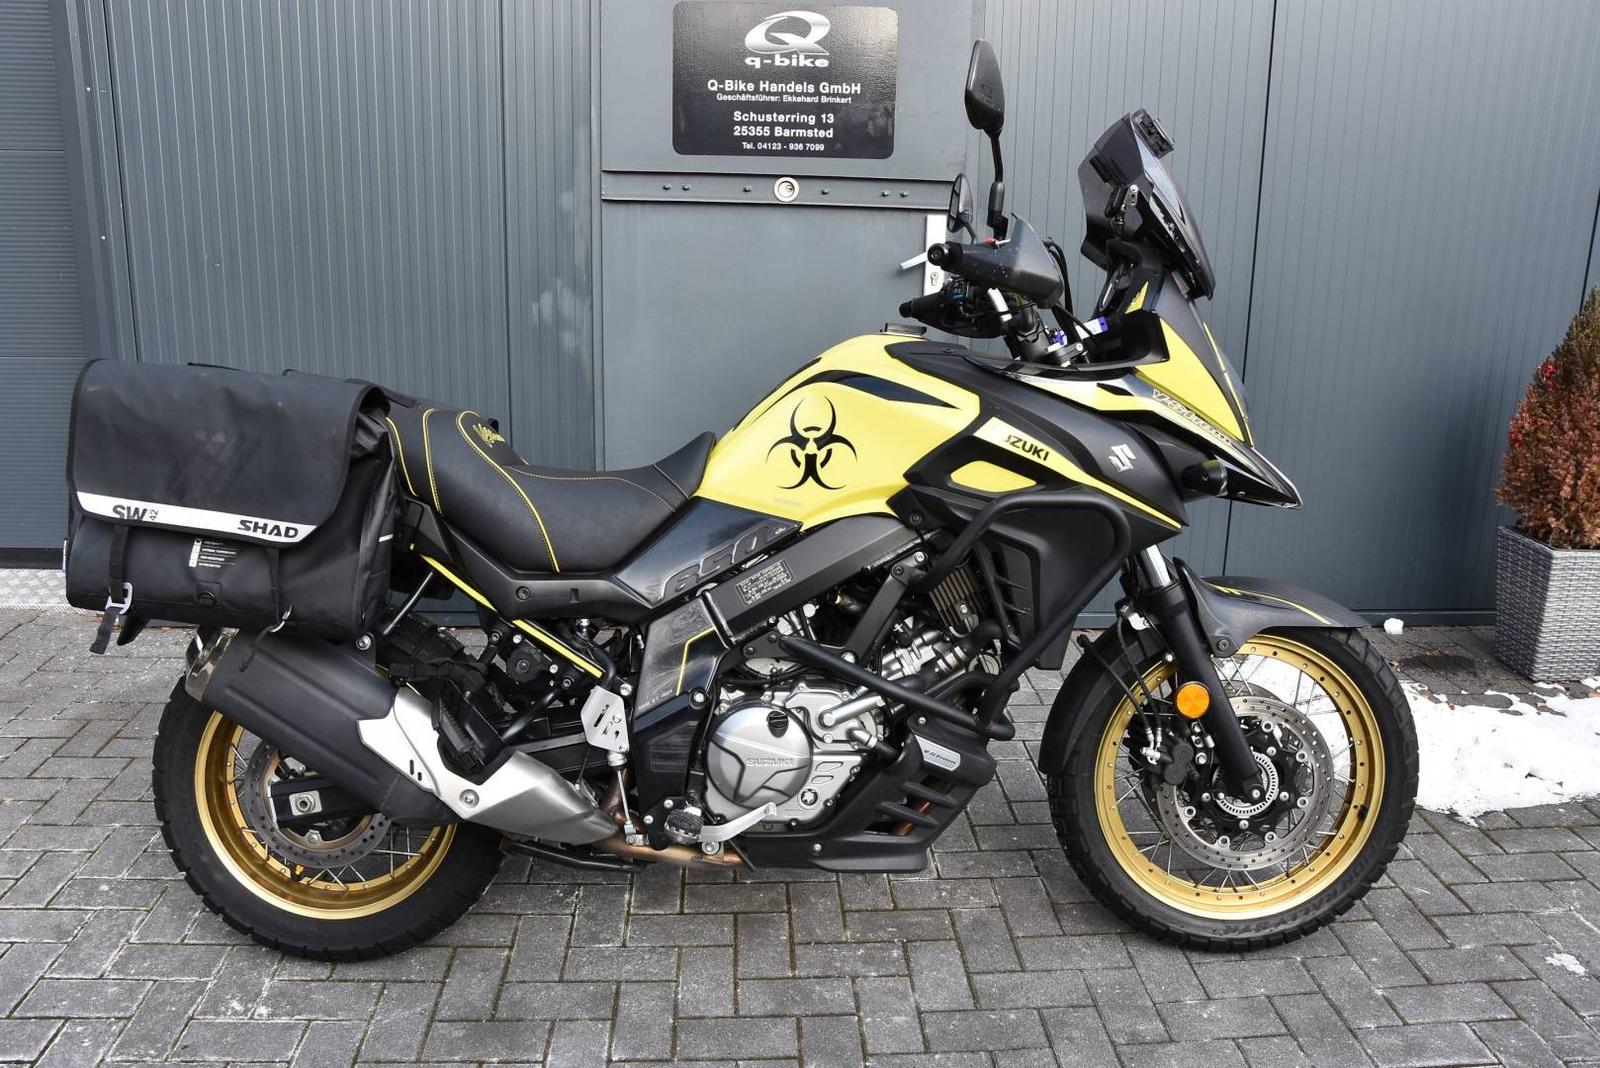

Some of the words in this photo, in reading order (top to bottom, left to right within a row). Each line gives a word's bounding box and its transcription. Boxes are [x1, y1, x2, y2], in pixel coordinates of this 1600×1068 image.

[745, 53, 829, 69] q-bike
[707, 79, 755, 92] Q-Bike
[759, 80, 815, 93] Handels
[819, 82, 861, 94] GmbH
[716, 92, 781, 102] Geschäftsführer:
[782, 94, 819, 103] Ekkehard
[820, 96, 852, 104] Brinkert
[733, 111, 816, 125] Schusterring
[820, 113, 835, 124] 13
[733, 126, 770, 137] 25355
[774, 127, 834, 138] Barmsted
[742, 141, 755, 150] Tel.
[757, 142, 782, 150] 04123
[788, 142, 804, 151] 936
[805, 143, 825, 151] 7099
[112, 504, 148, 520] SW
[237, 519, 299, 538] SHAD
